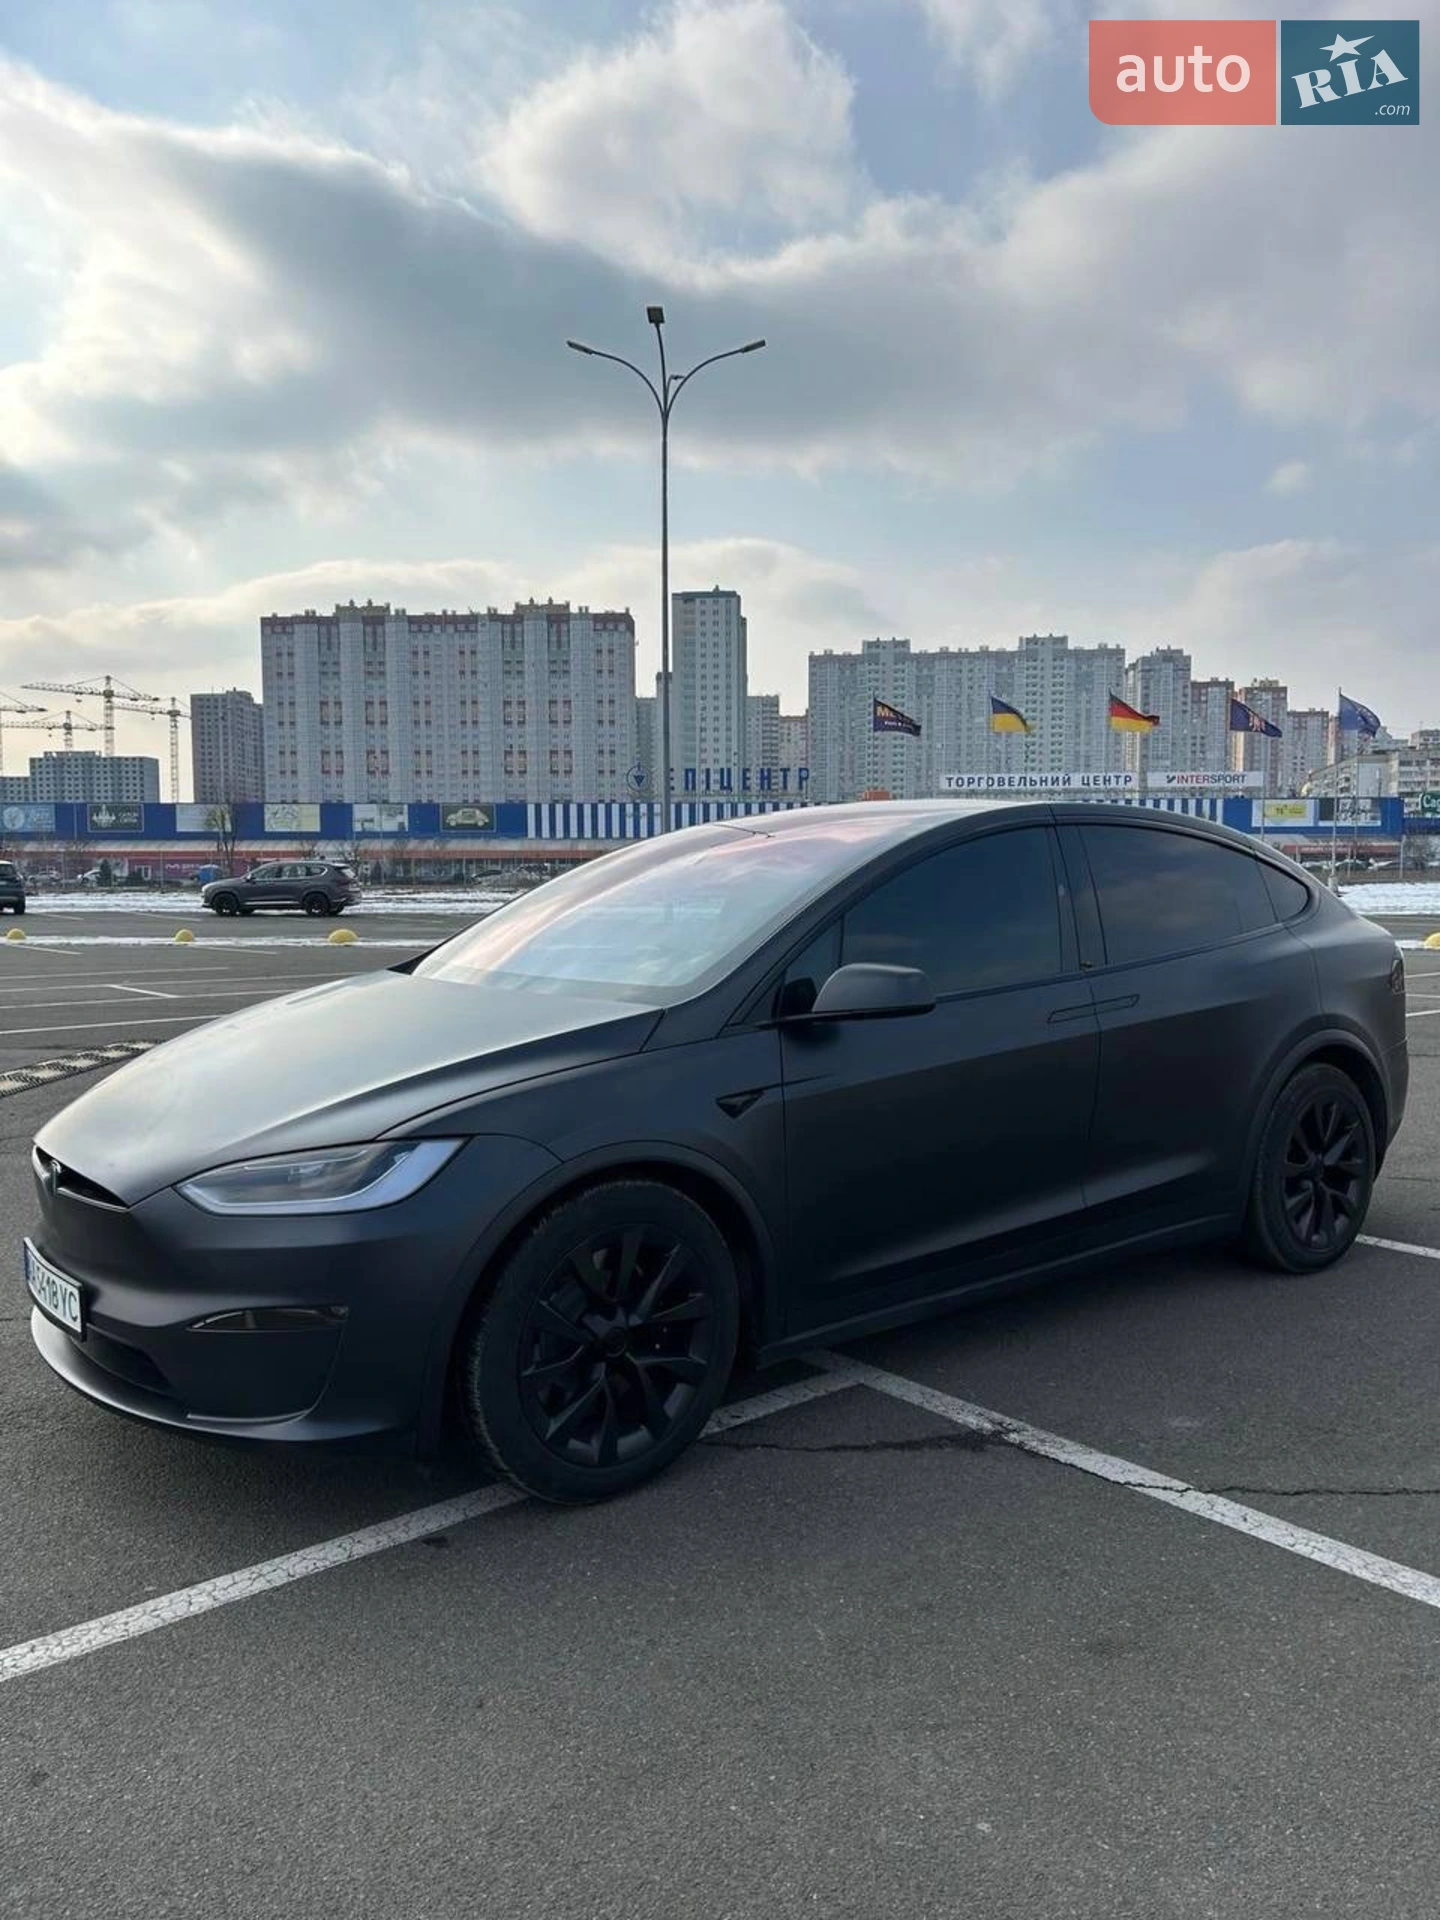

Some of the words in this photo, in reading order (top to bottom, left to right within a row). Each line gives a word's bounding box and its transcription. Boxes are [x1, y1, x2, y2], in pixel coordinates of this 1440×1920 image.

[945, 773, 1072, 788] ТОРГОВЕЛЬНИЙ
[1080, 774, 1133, 787] ЦЕНТР
[1176, 773, 1247, 785] INTERSPORT
